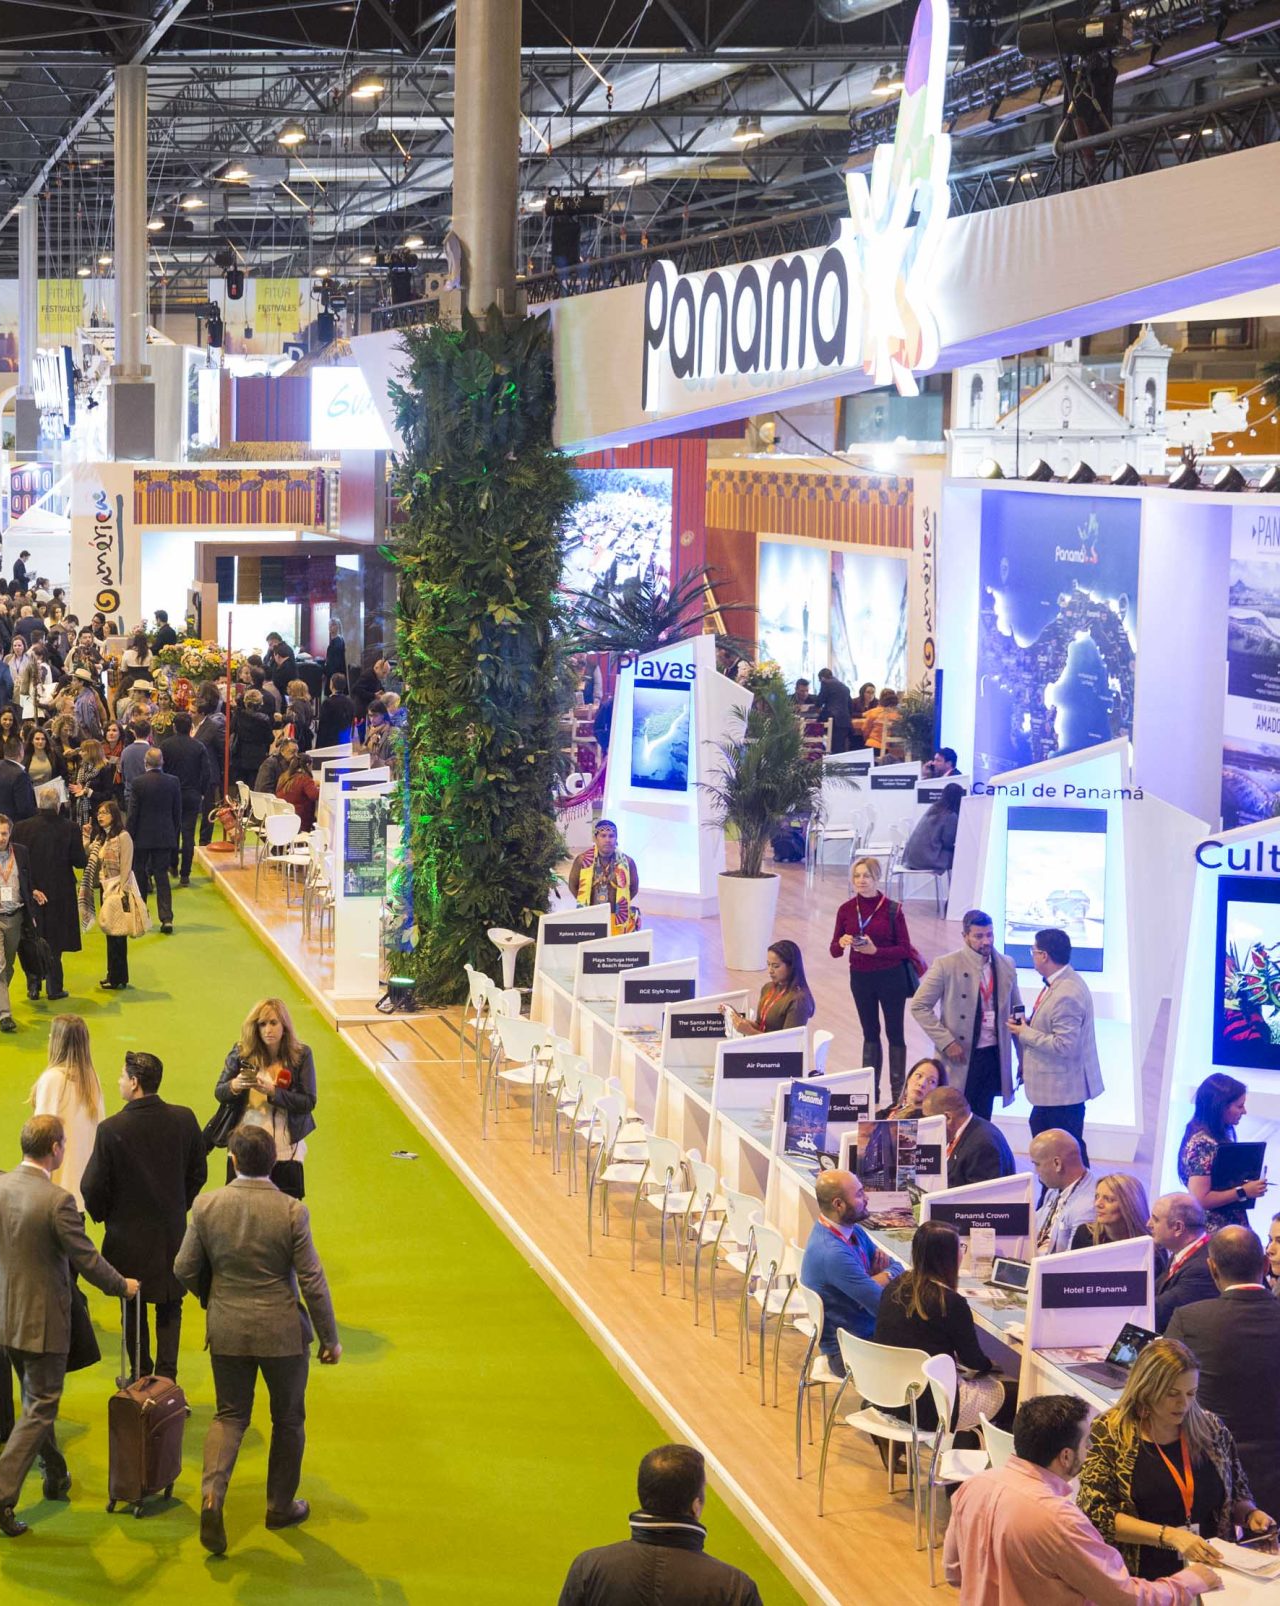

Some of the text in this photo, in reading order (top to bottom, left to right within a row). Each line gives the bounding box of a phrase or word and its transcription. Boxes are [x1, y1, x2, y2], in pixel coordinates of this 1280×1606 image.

[288, 346, 304, 361] D
[617, 653, 697, 680] Playas
[972, 782, 1143, 800] Canal de Panamá
[1063, 1286, 1085, 1294] Hotel
[1095, 1285, 1128, 1293] Panamá
